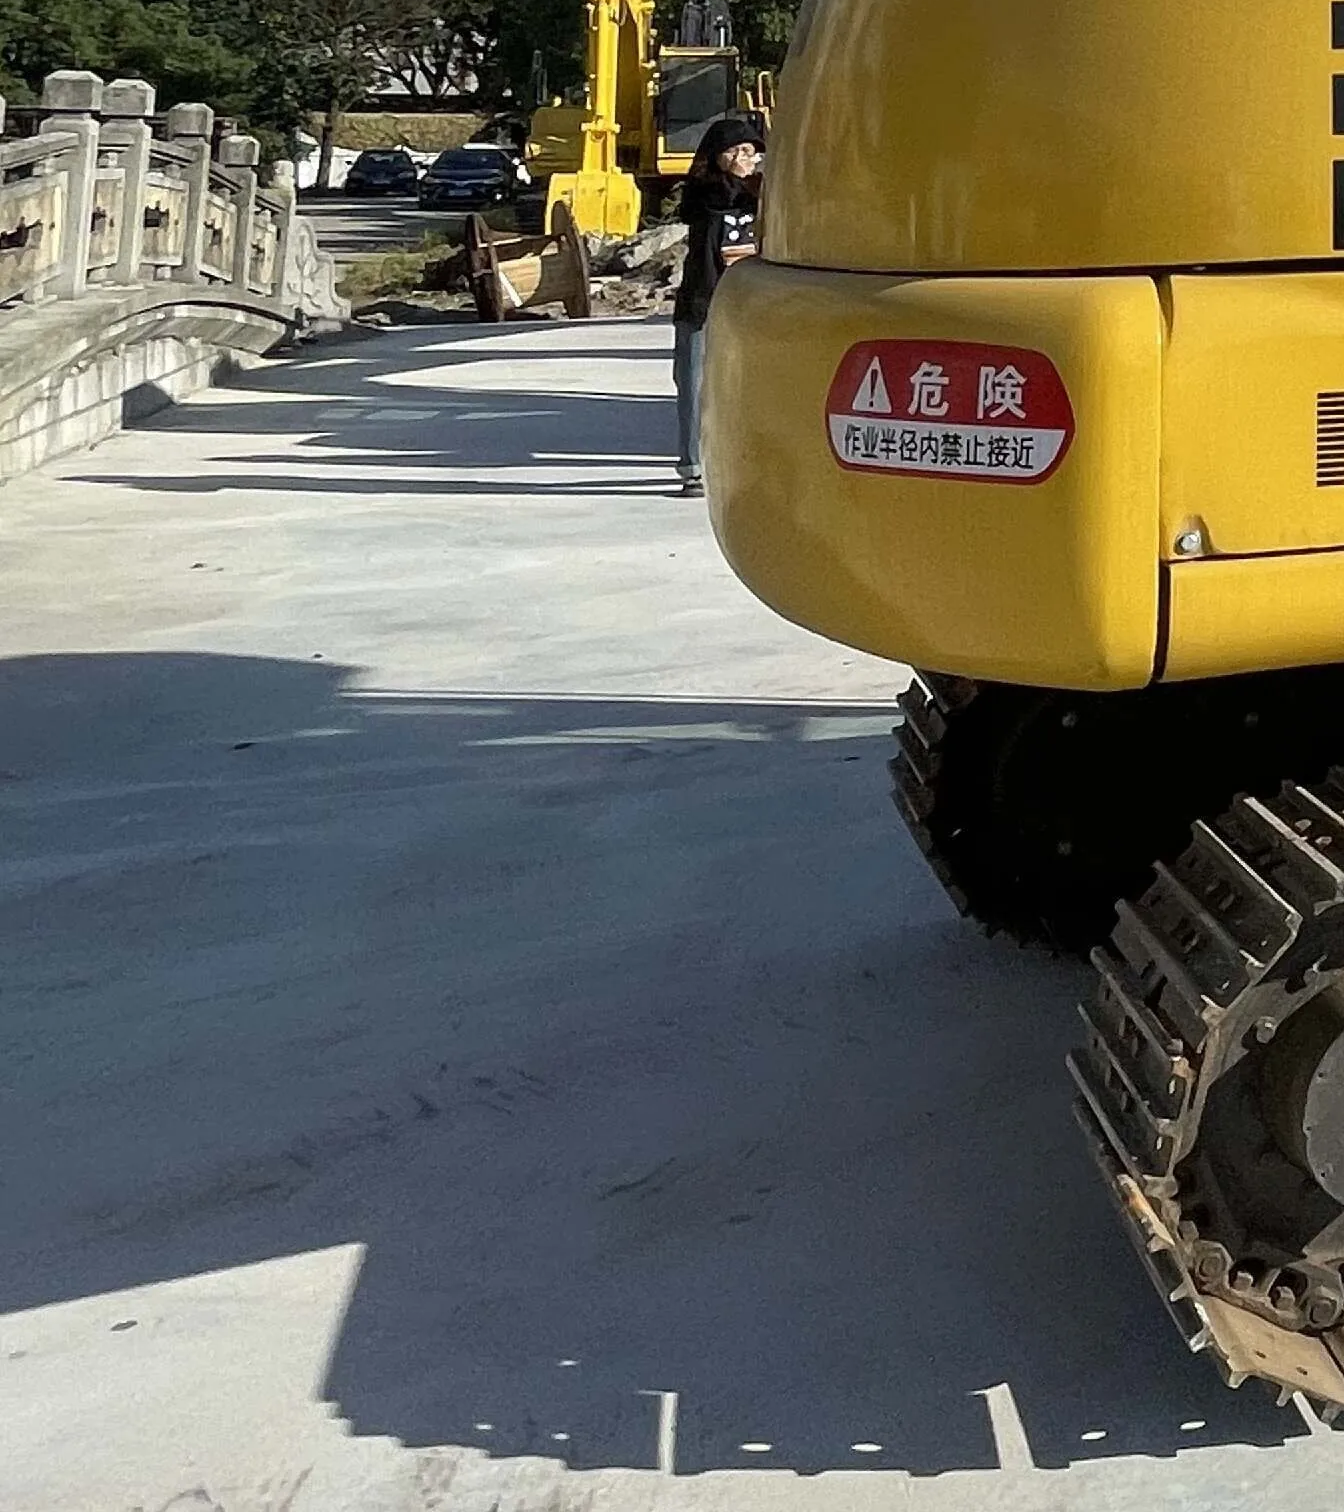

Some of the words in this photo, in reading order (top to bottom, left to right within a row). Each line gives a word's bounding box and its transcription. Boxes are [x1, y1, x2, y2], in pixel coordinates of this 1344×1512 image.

[844, 423, 1035, 470] 作业半径内禁止接近
